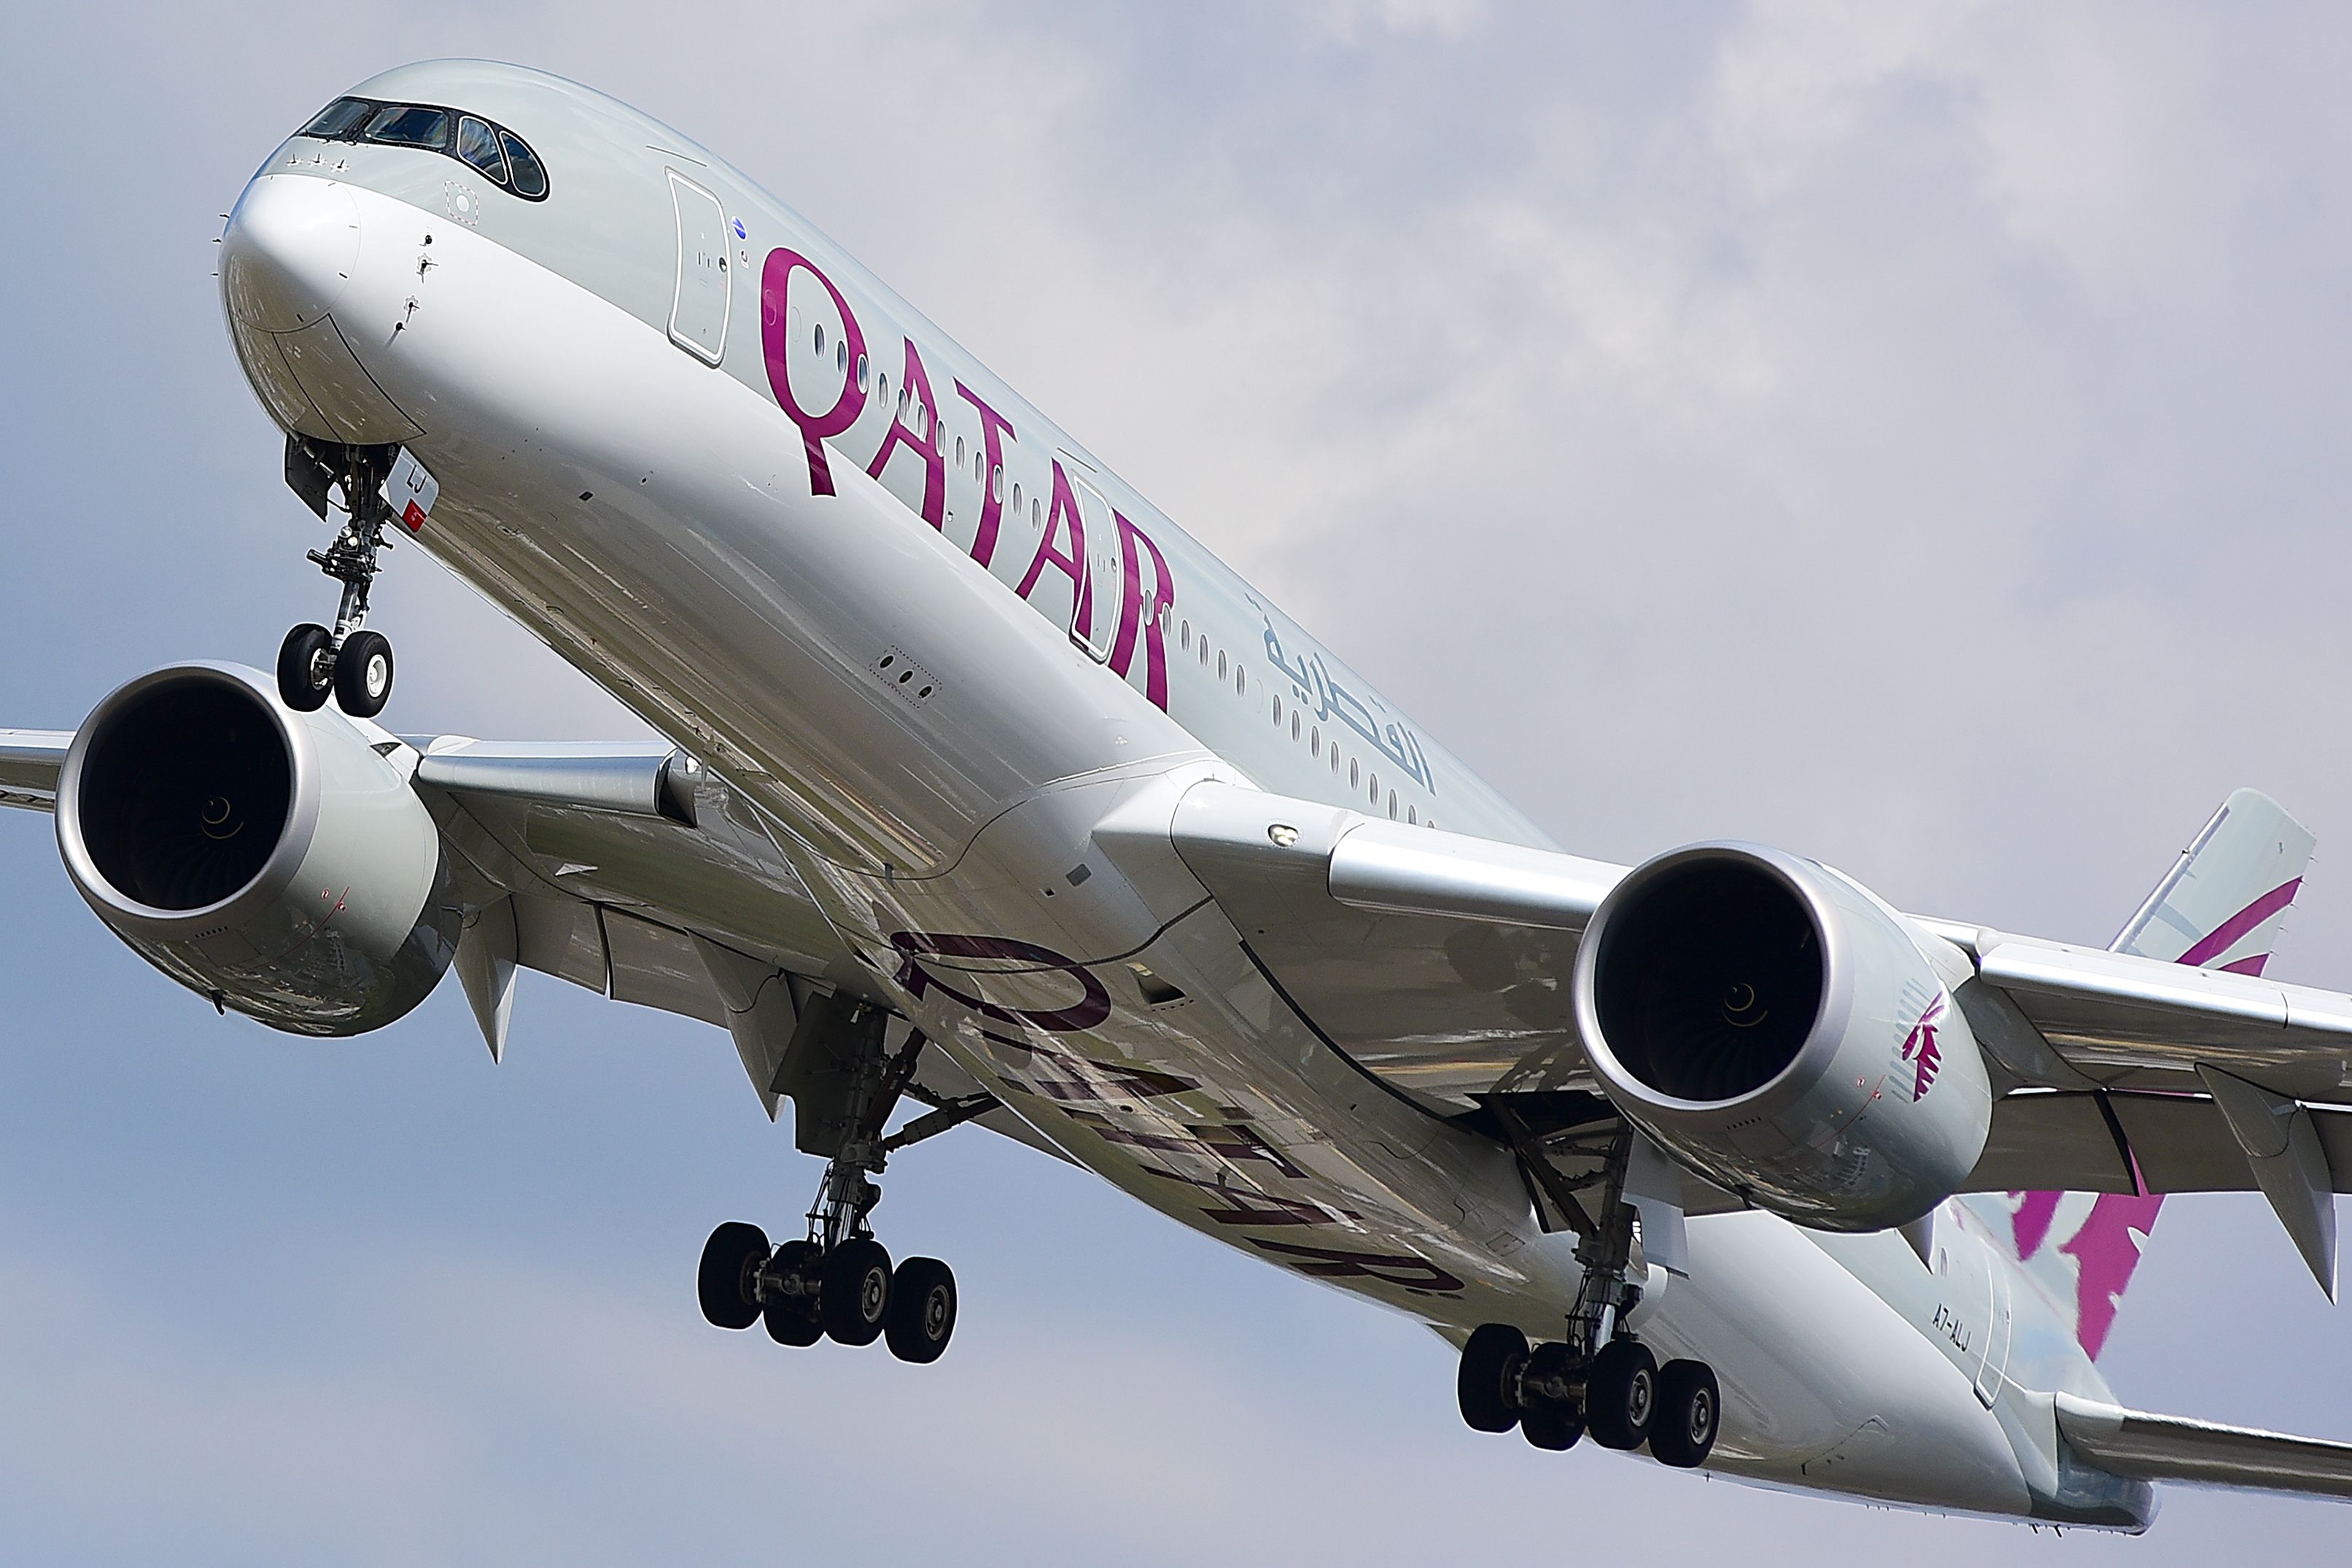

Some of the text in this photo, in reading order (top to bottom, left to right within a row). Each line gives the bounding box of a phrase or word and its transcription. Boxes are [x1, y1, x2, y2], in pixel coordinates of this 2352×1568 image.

[406, 464, 427, 494] LJ
[761, 247, 1175, 715] QATAR
[1244, 592, 1437, 797] القطرية
[890, 931, 1466, 1292] QATAR
[1932, 1303, 1971, 1352] A7-ALJ
